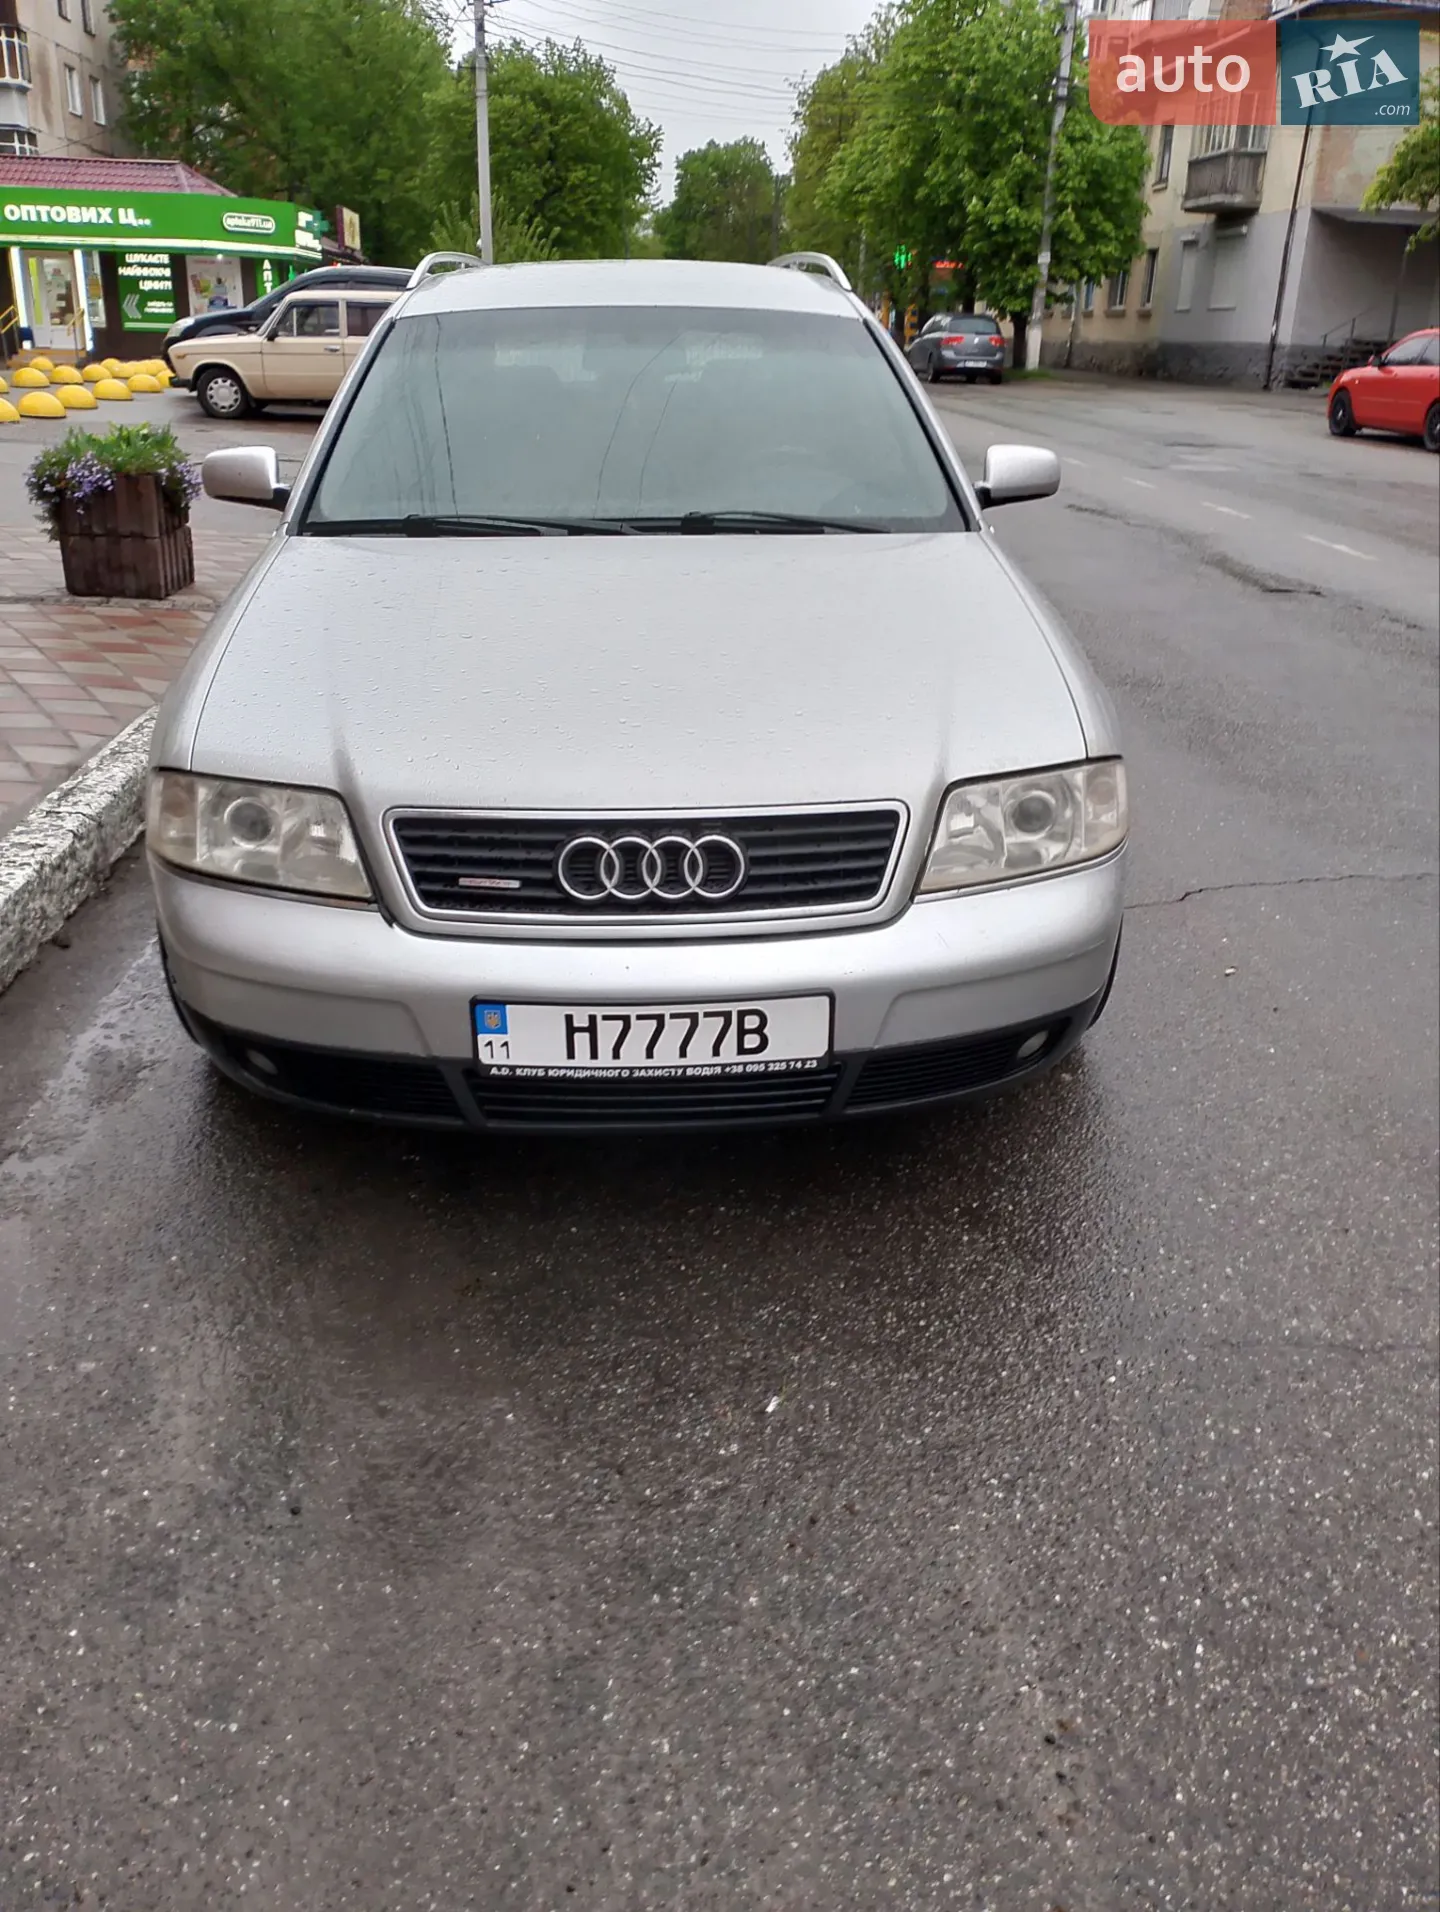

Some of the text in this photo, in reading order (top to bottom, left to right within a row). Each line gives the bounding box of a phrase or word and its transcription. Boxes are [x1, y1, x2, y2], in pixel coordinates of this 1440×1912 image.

[4, 204, 113, 224] ОПТОВИХ
[564, 1008, 769, 1060] H7777B
[483, 1040, 511, 1060] 11
[515, 1067, 546, 1077] КЛУБ
[548, 1068, 631, 1079] ЮРИДИЧНОГО
[632, 1067, 685, 1078] ЗАХИСТУ
[686, 1066, 721, 1077] ВОДІЯ
[724, 1065, 744, 1074] +38
